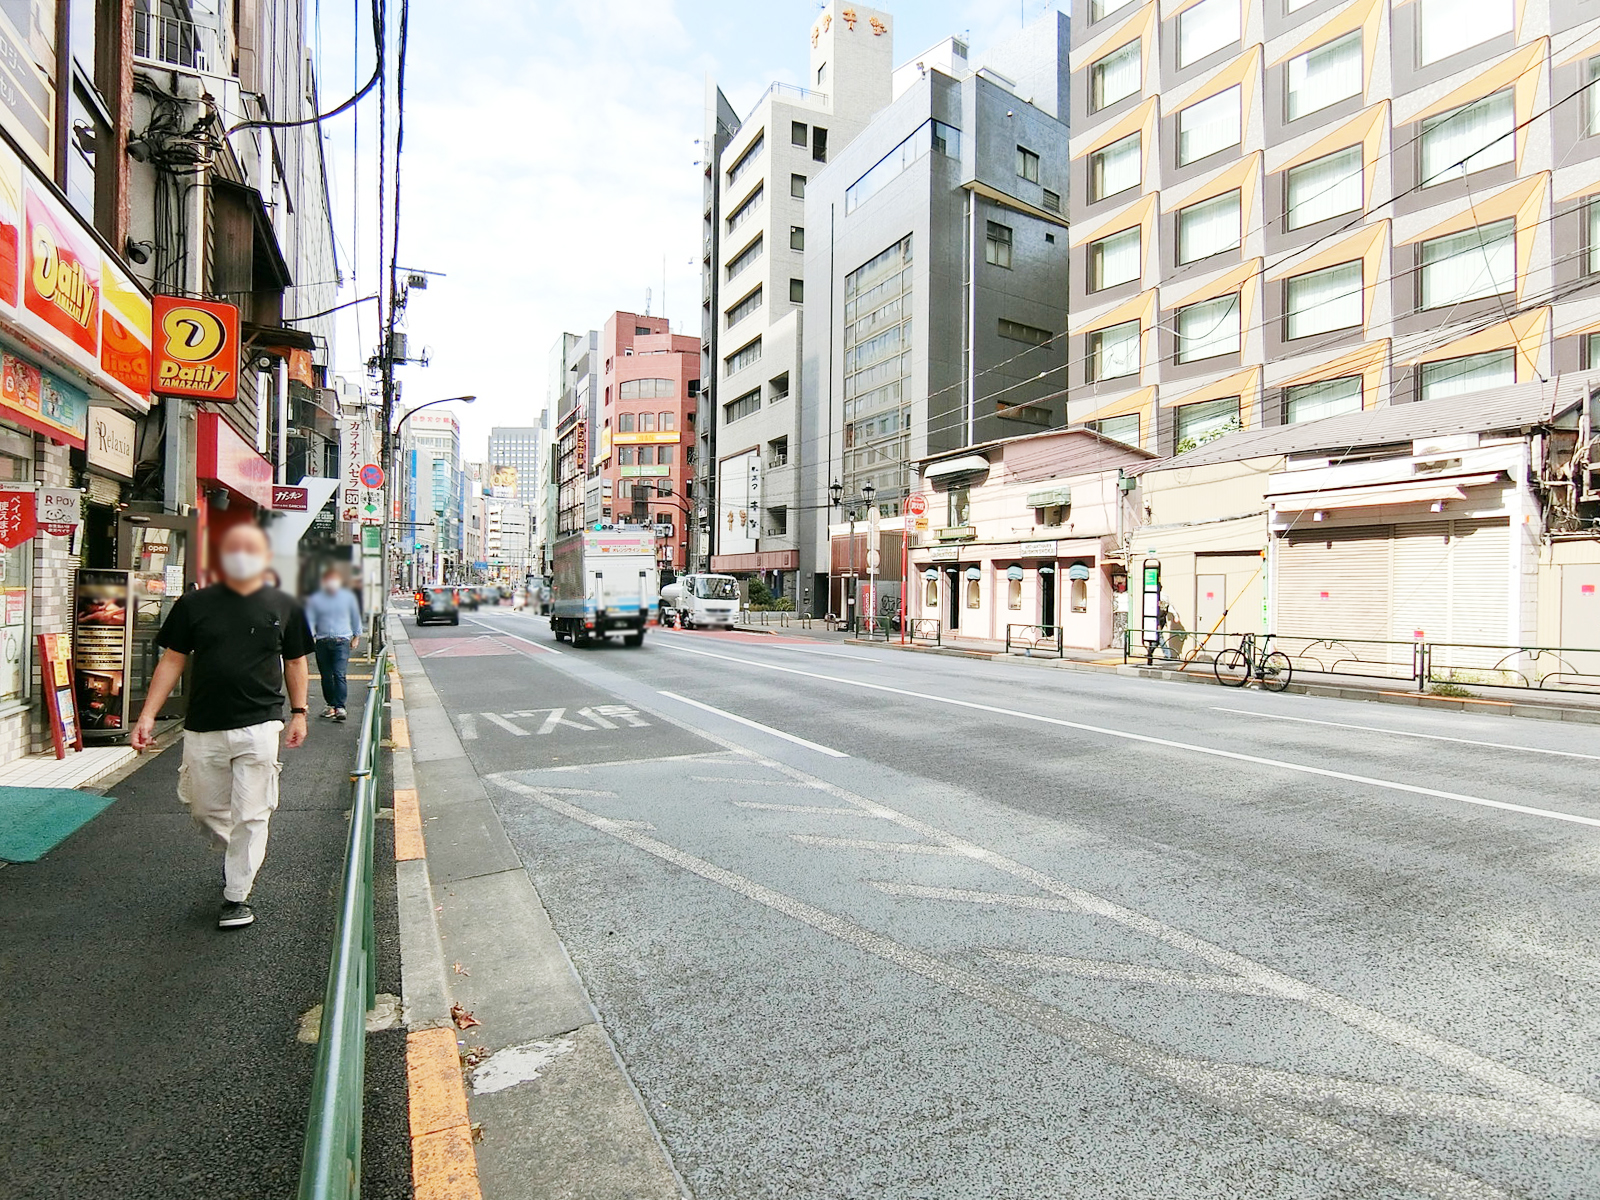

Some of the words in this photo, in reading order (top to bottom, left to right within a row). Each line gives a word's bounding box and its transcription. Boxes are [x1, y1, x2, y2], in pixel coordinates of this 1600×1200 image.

[32, 223, 96, 329] Daily
[159, 377, 210, 391] YAMAZAKI
[160, 360, 230, 391] Daily
[98, 421, 130, 457] Relaxia
[10, 494, 21, 531] ペイペイ
[56, 496, 76, 507] Pay
[148, 545, 168, 553] open
